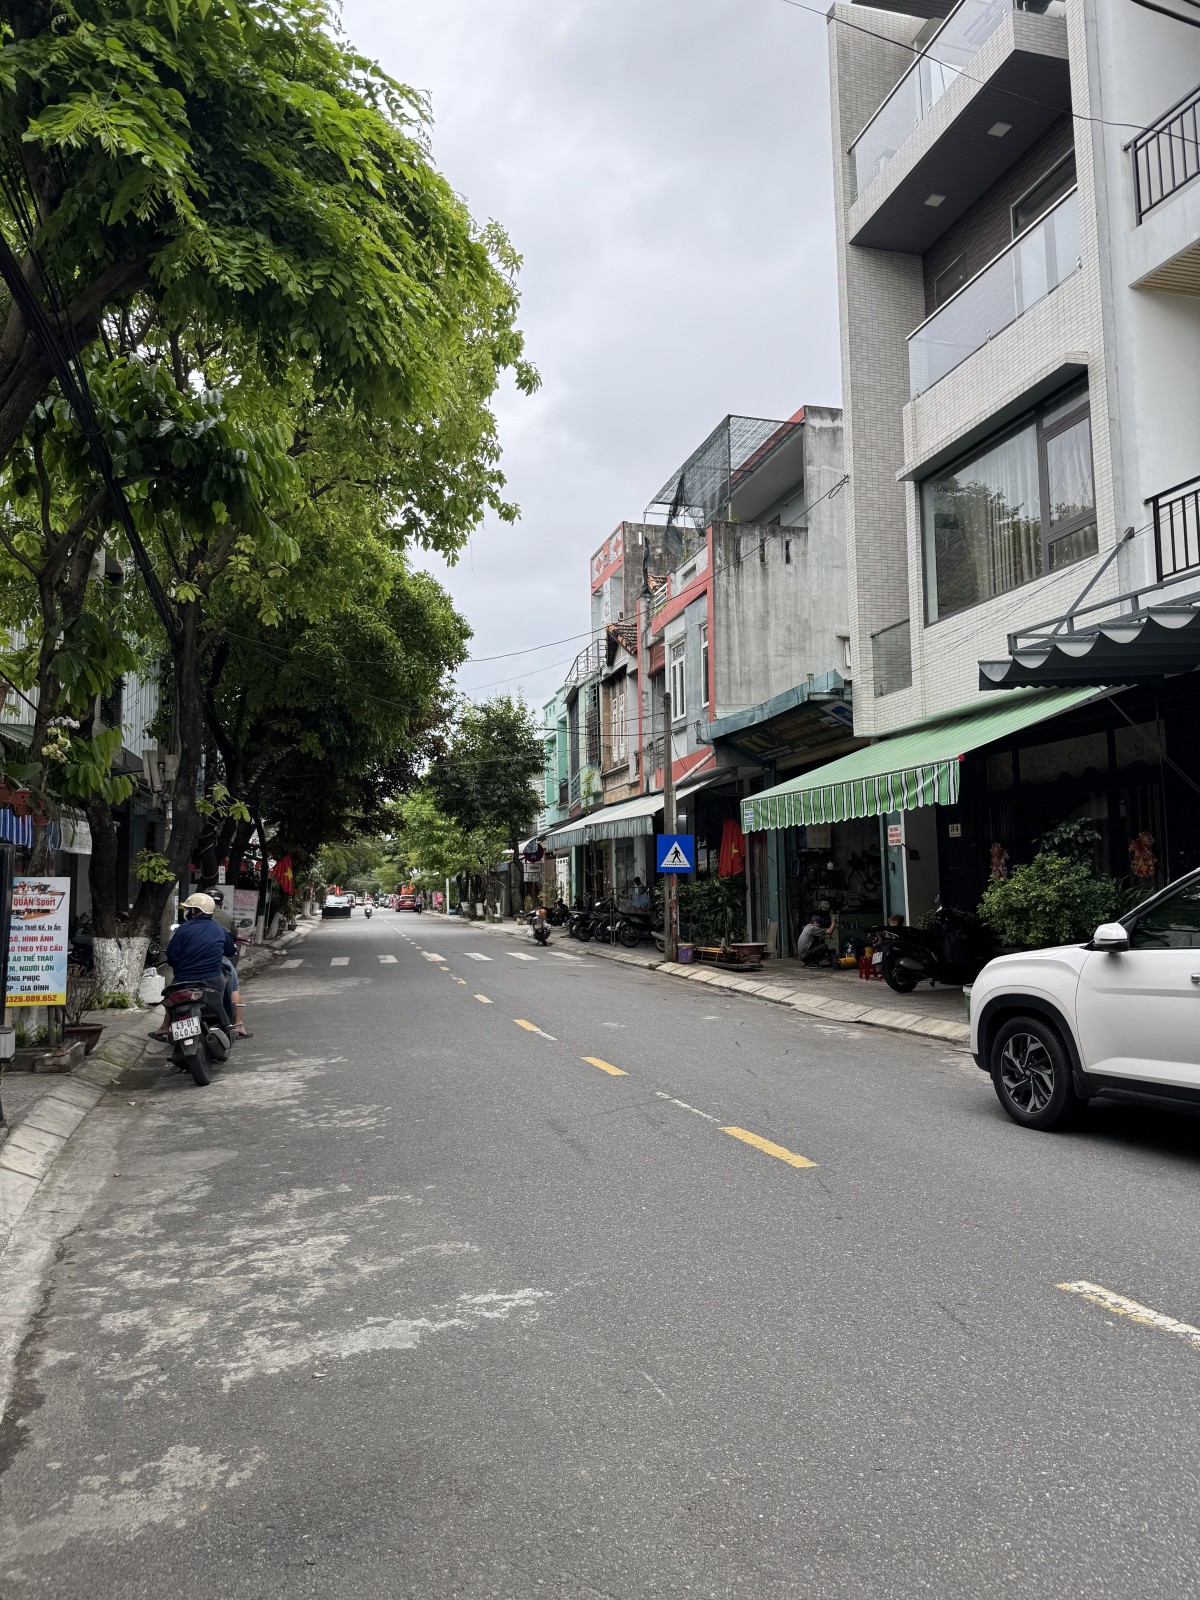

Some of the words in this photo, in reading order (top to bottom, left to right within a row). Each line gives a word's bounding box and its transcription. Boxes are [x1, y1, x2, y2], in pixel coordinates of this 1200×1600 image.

[36, 898, 56, 907] Sport
[40, 934, 54, 942] ẢNH
[23, 953, 35, 962] THỂ
[19, 964, 40, 972] NGƯỜI
[22, 975, 40, 983] PHỤC
